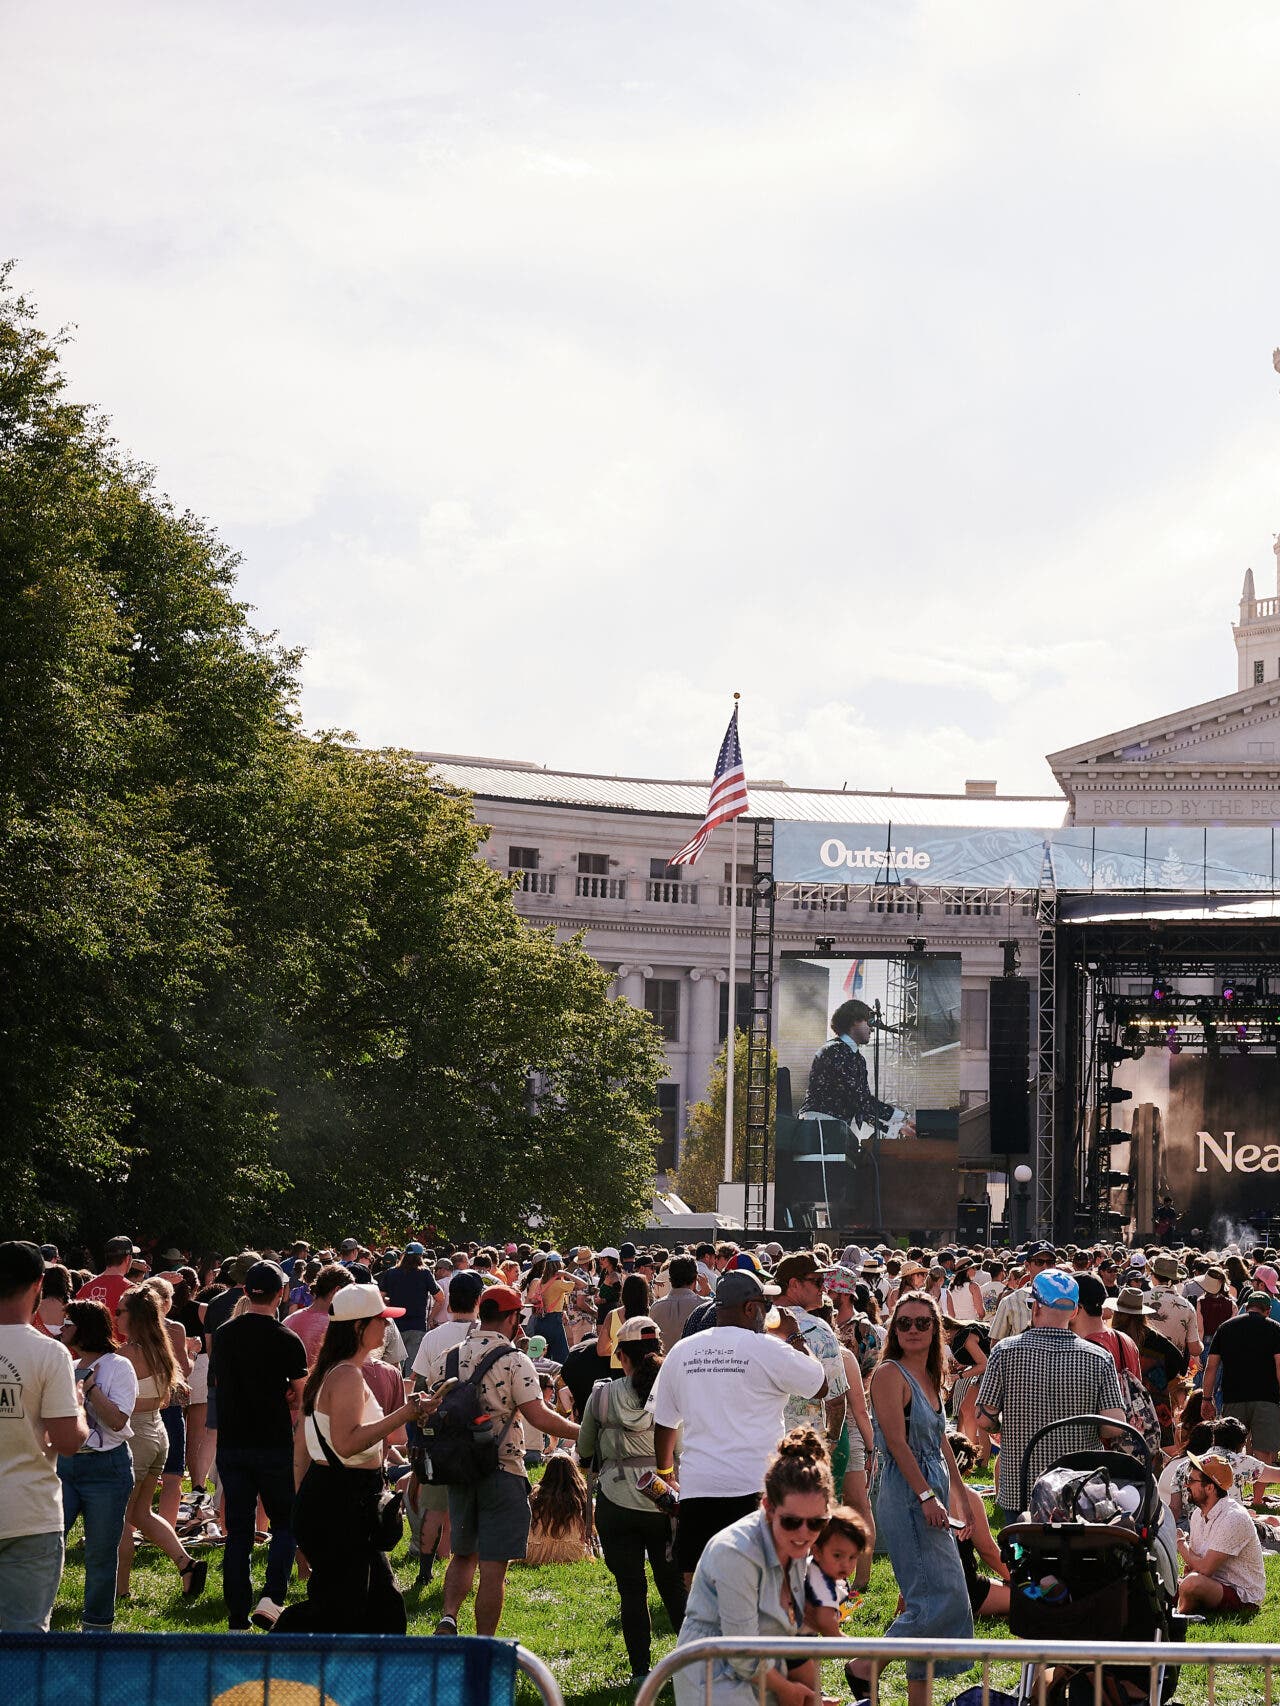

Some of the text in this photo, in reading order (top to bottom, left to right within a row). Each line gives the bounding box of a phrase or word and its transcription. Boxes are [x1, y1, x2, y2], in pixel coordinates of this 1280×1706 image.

[1093, 799, 1173, 815] ERECTED
[1181, 799, 1200, 815] BY
[1208, 799, 1243, 815] THE
[819, 838, 931, 869] Outside
[0, 1388, 15, 1406] AI
